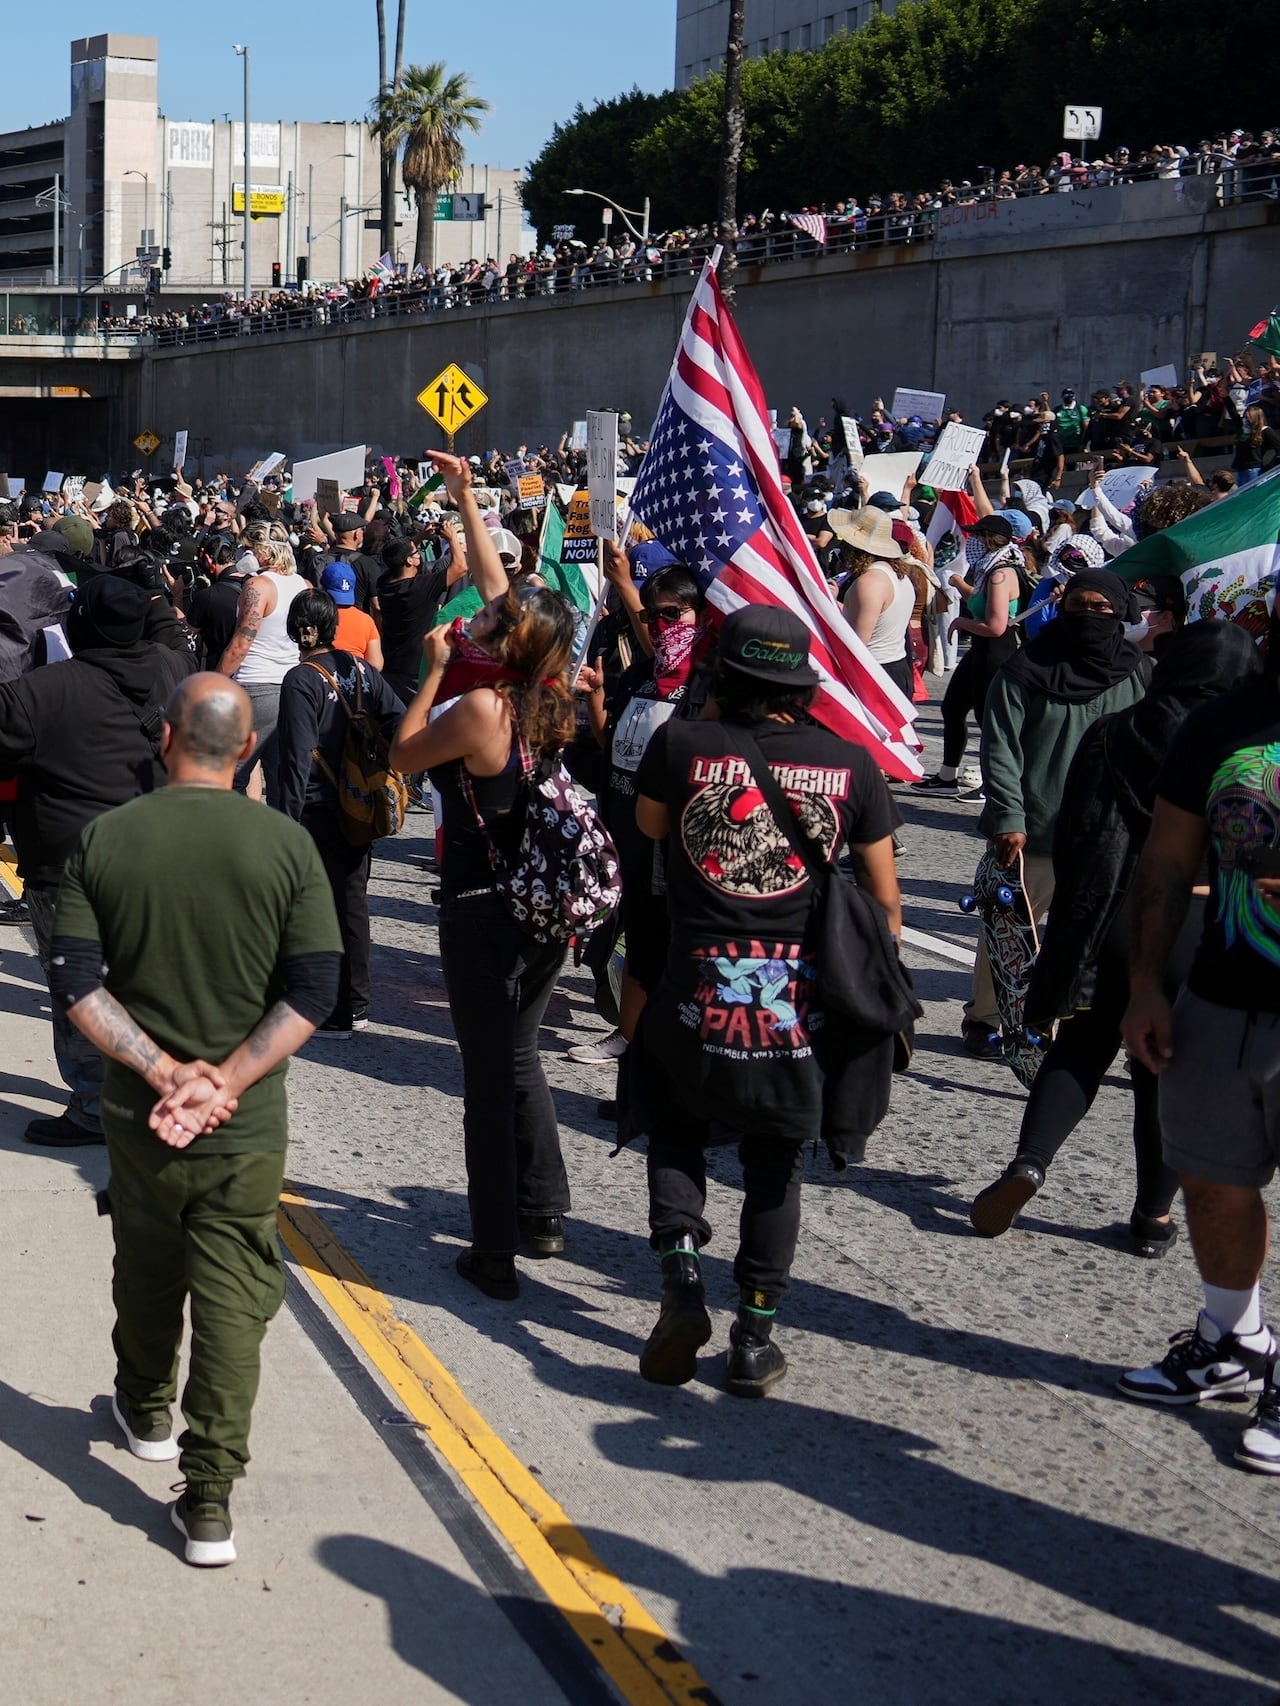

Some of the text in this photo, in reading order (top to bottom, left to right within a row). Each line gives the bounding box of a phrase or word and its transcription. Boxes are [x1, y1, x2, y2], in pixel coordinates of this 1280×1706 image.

[169, 127, 211, 161] PARK
[1104, 474, 1137, 487] UCK
[564, 539, 593, 548] MUST
[741, 638, 804, 670] Galaxy
[694, 982, 716, 1005] IN
[699, 1005, 811, 1049] PARK
[702, 1043, 749, 1061] NOVEMBER
[752, 1050, 767, 1060] 4TH
[791, 1046, 813, 1059] 2023
